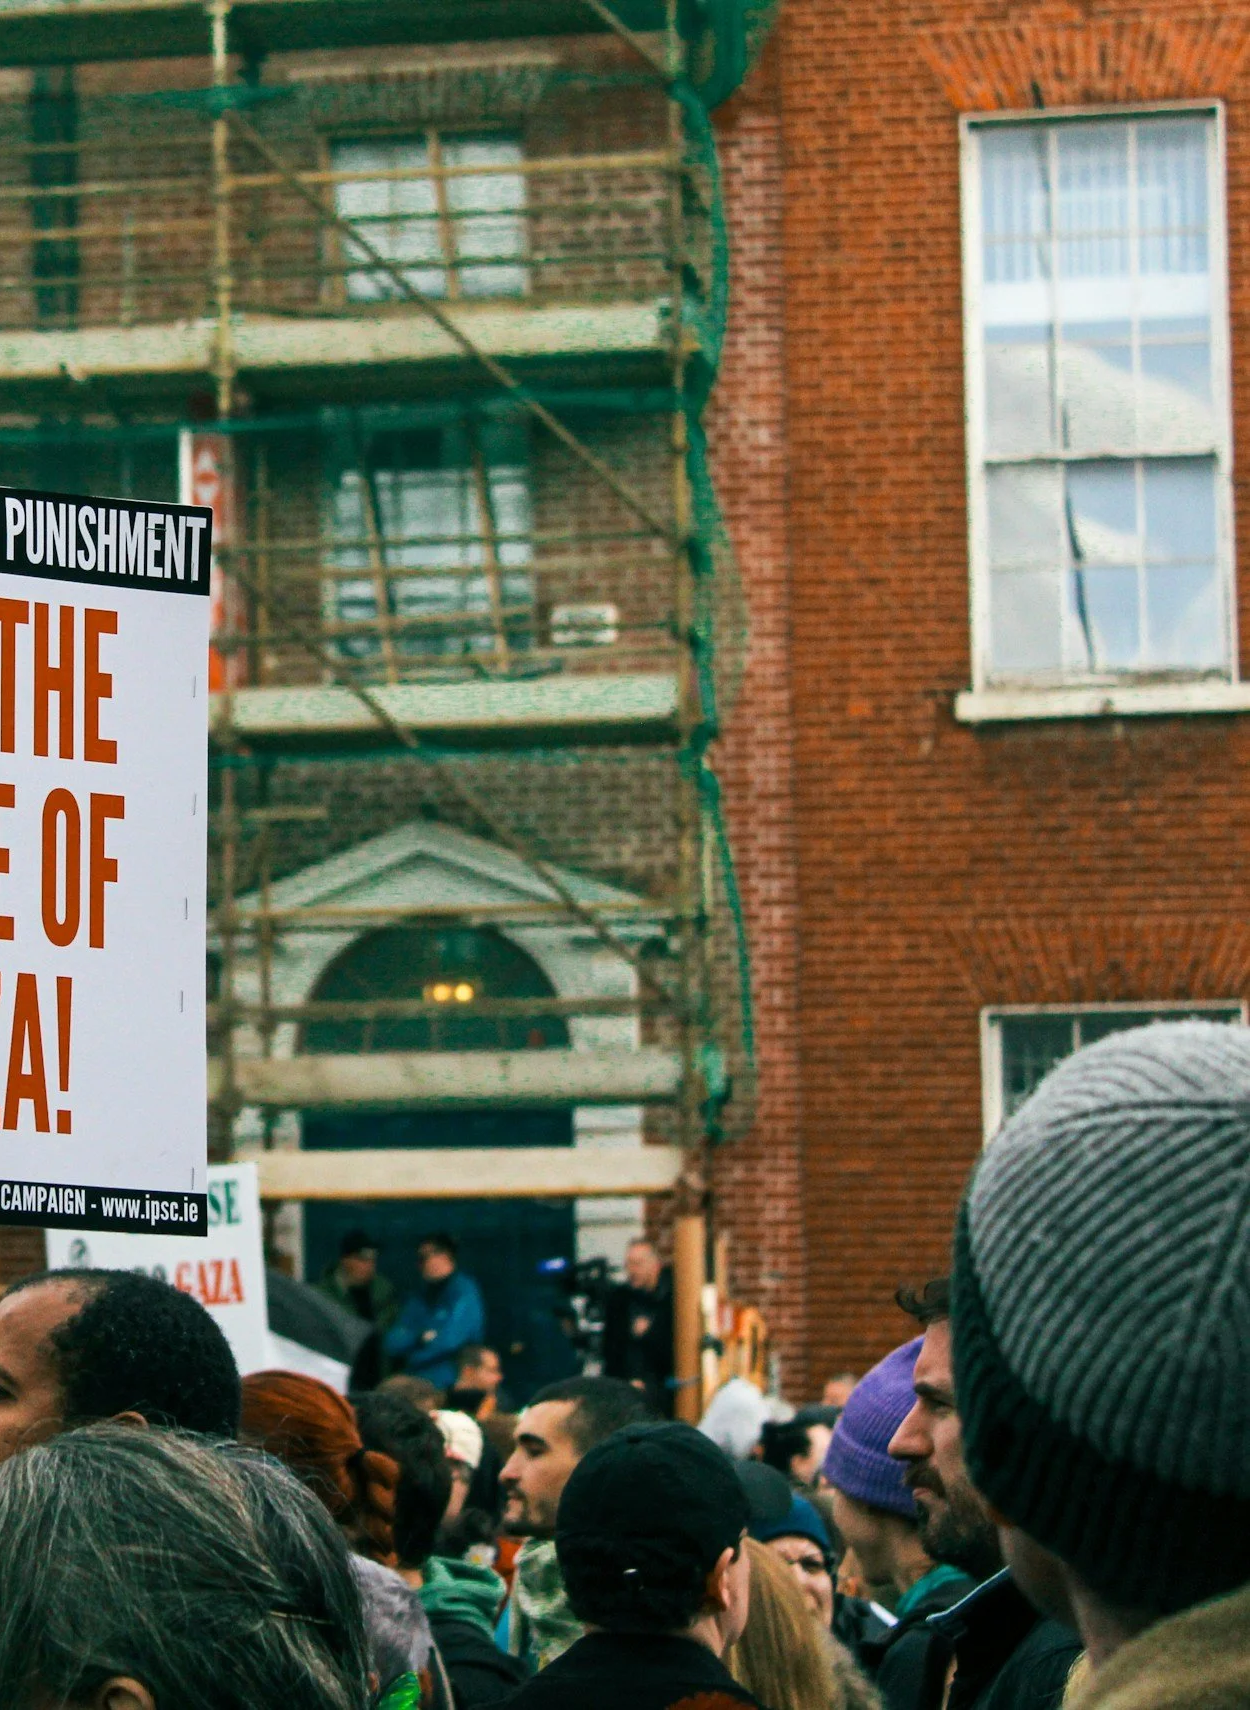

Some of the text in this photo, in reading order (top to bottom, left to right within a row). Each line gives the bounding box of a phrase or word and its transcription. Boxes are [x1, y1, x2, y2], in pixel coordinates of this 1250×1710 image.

[5, 497, 207, 582] PUNISHMENT
[41, 787, 125, 949] OF
[0, 1183, 86, 1215] CAMPAIGN
[101, 1194, 199, 1226] www.ipsc.ie
